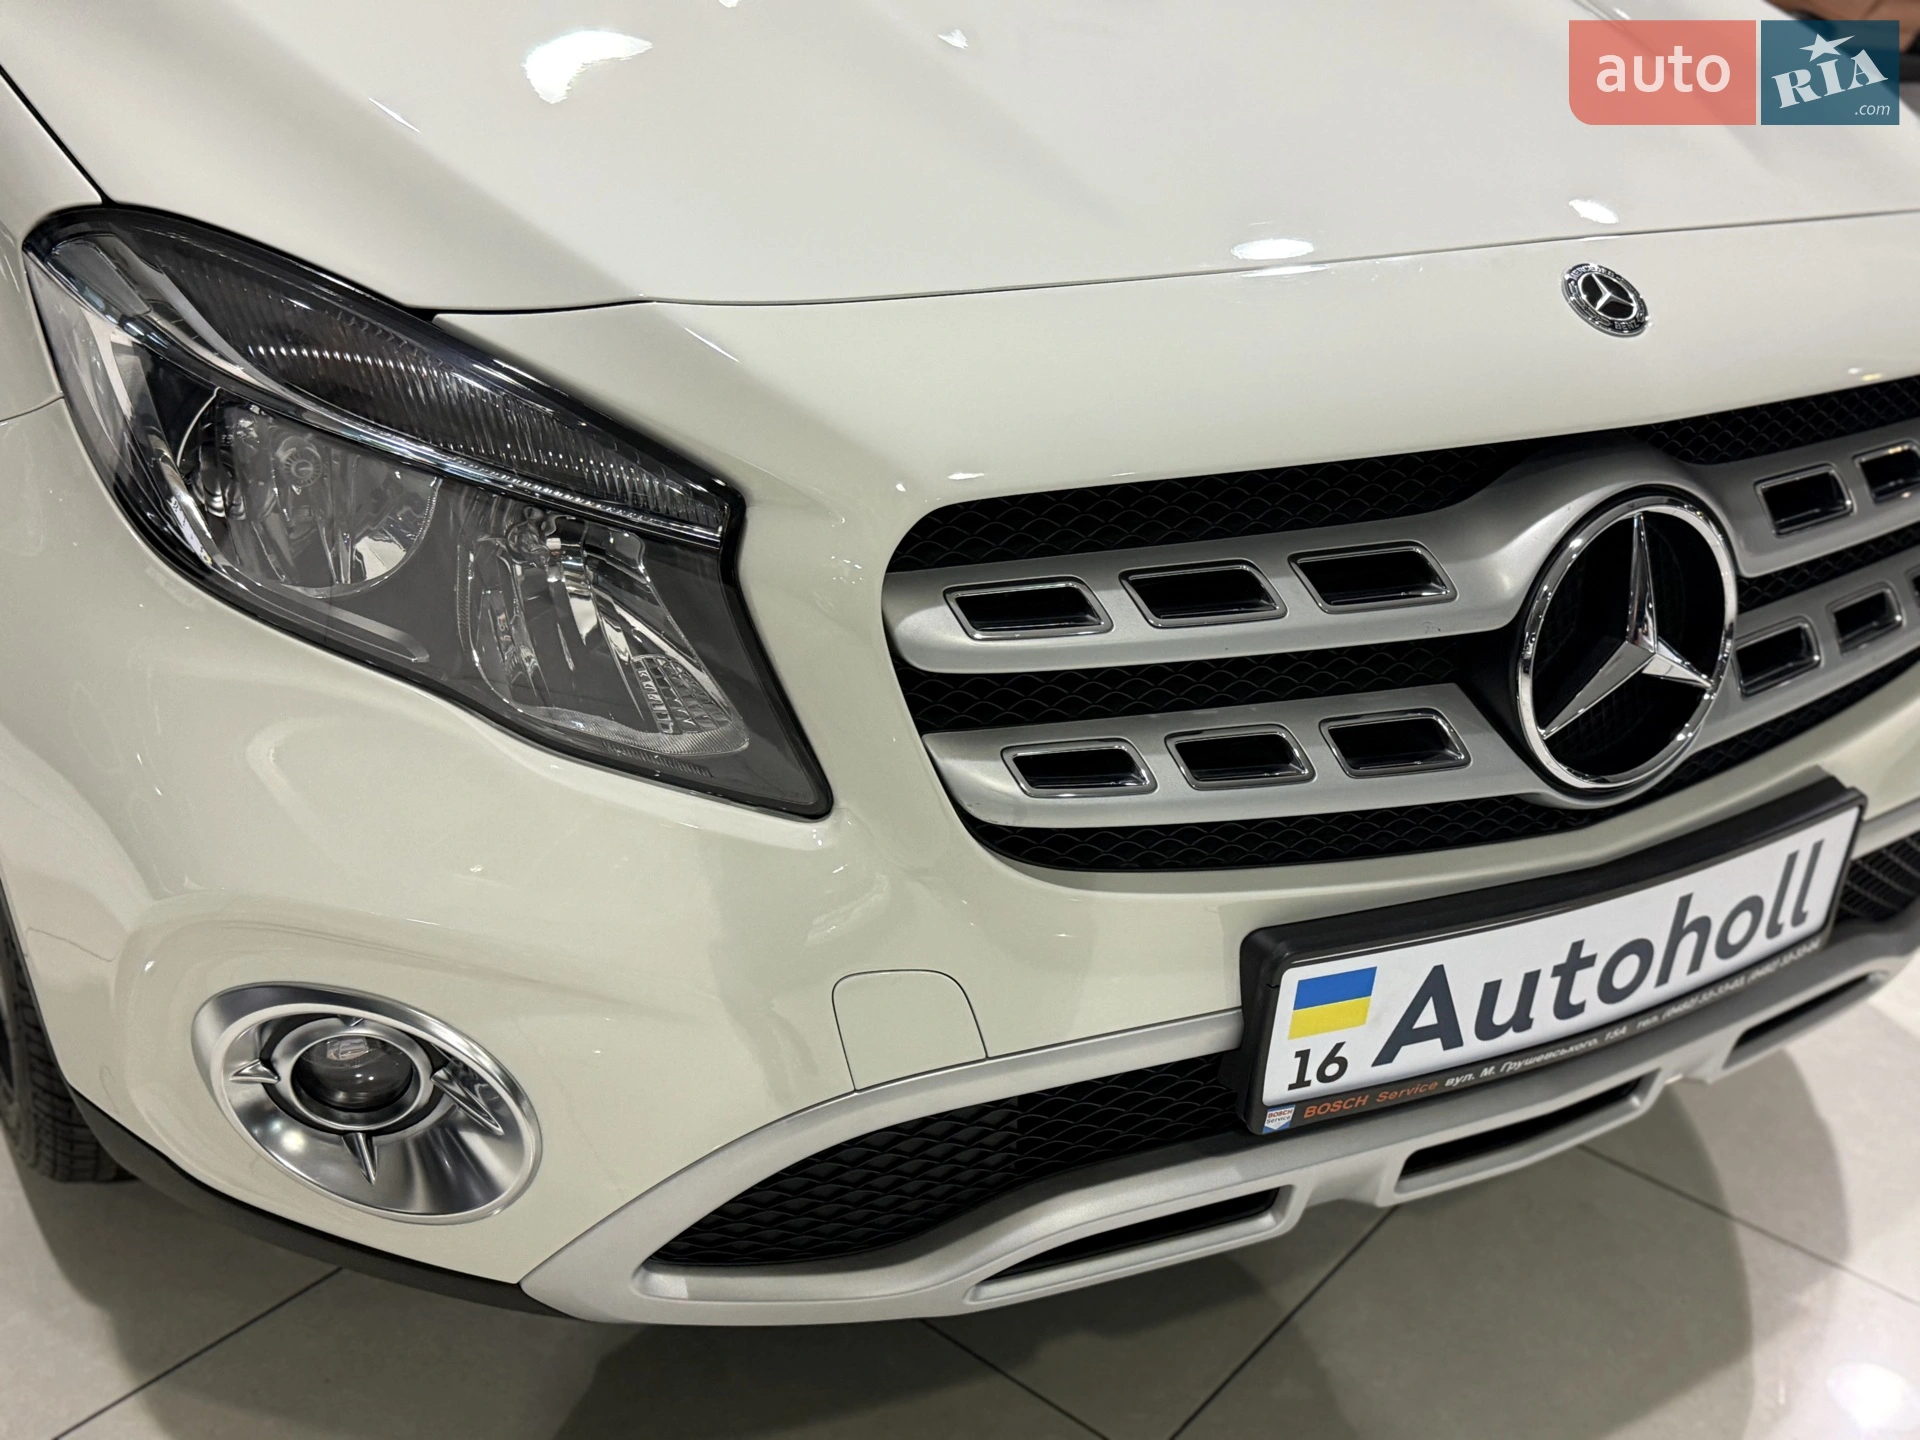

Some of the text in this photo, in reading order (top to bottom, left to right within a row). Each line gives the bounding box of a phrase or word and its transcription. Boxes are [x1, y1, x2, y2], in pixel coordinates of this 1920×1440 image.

[1614, 319, 1640, 330] BENZ
[1371, 838, 1825, 1067] Autoholl
[1287, 1041, 1349, 1091] 16
[1444, 1074, 1475, 1088] вул.
[1479, 1066, 1495, 1079] М.
[1303, 1081, 1439, 1119] BOSCH Service
[1266, 1114, 1291, 1125] Service
[1267, 1109, 1294, 1119] BOSCH
